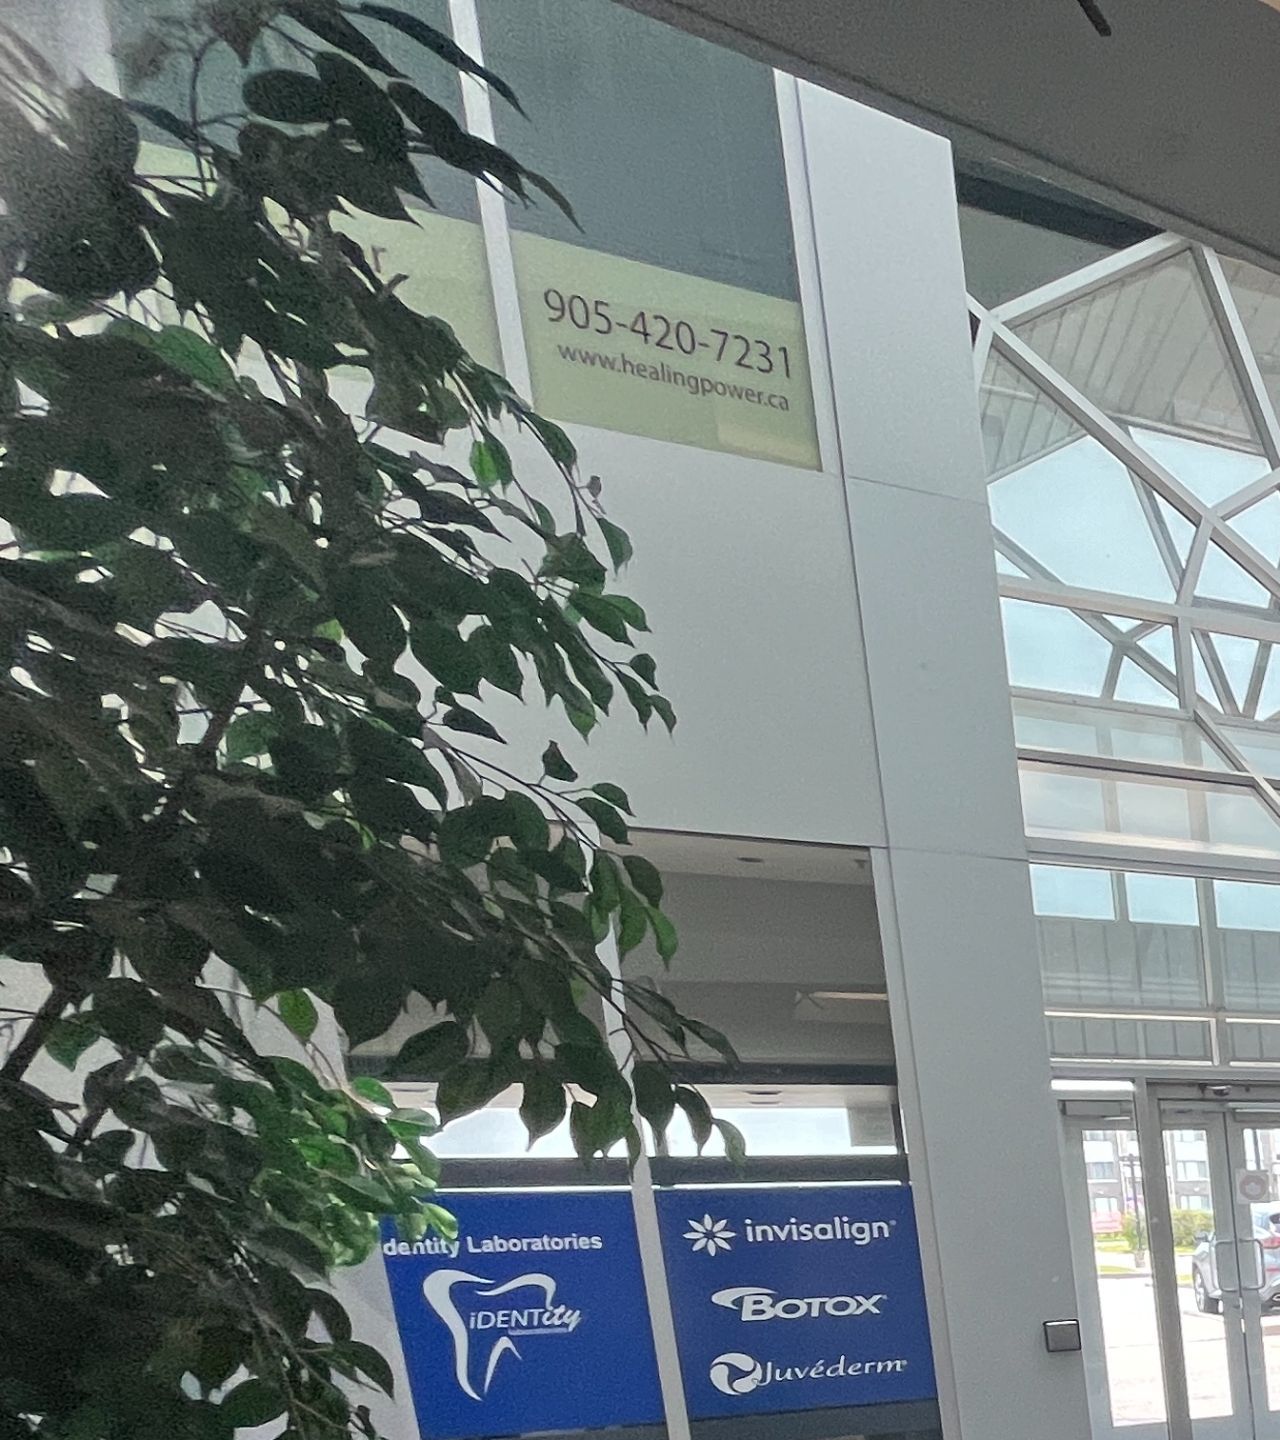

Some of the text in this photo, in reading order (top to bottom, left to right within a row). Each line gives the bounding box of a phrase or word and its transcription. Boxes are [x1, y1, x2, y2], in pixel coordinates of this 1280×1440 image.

[543, 288, 791, 378] 905-420-7231
[557, 343, 790, 411] www.healingpower.ca
[466, 1233, 603, 1253] Laboratories
[745, 1216, 890, 1245] invisalign
[469, 1305, 582, 1332] iDENTity
[741, 1294, 884, 1321] BOTOX
[757, 1354, 902, 1386] Juvéderm
